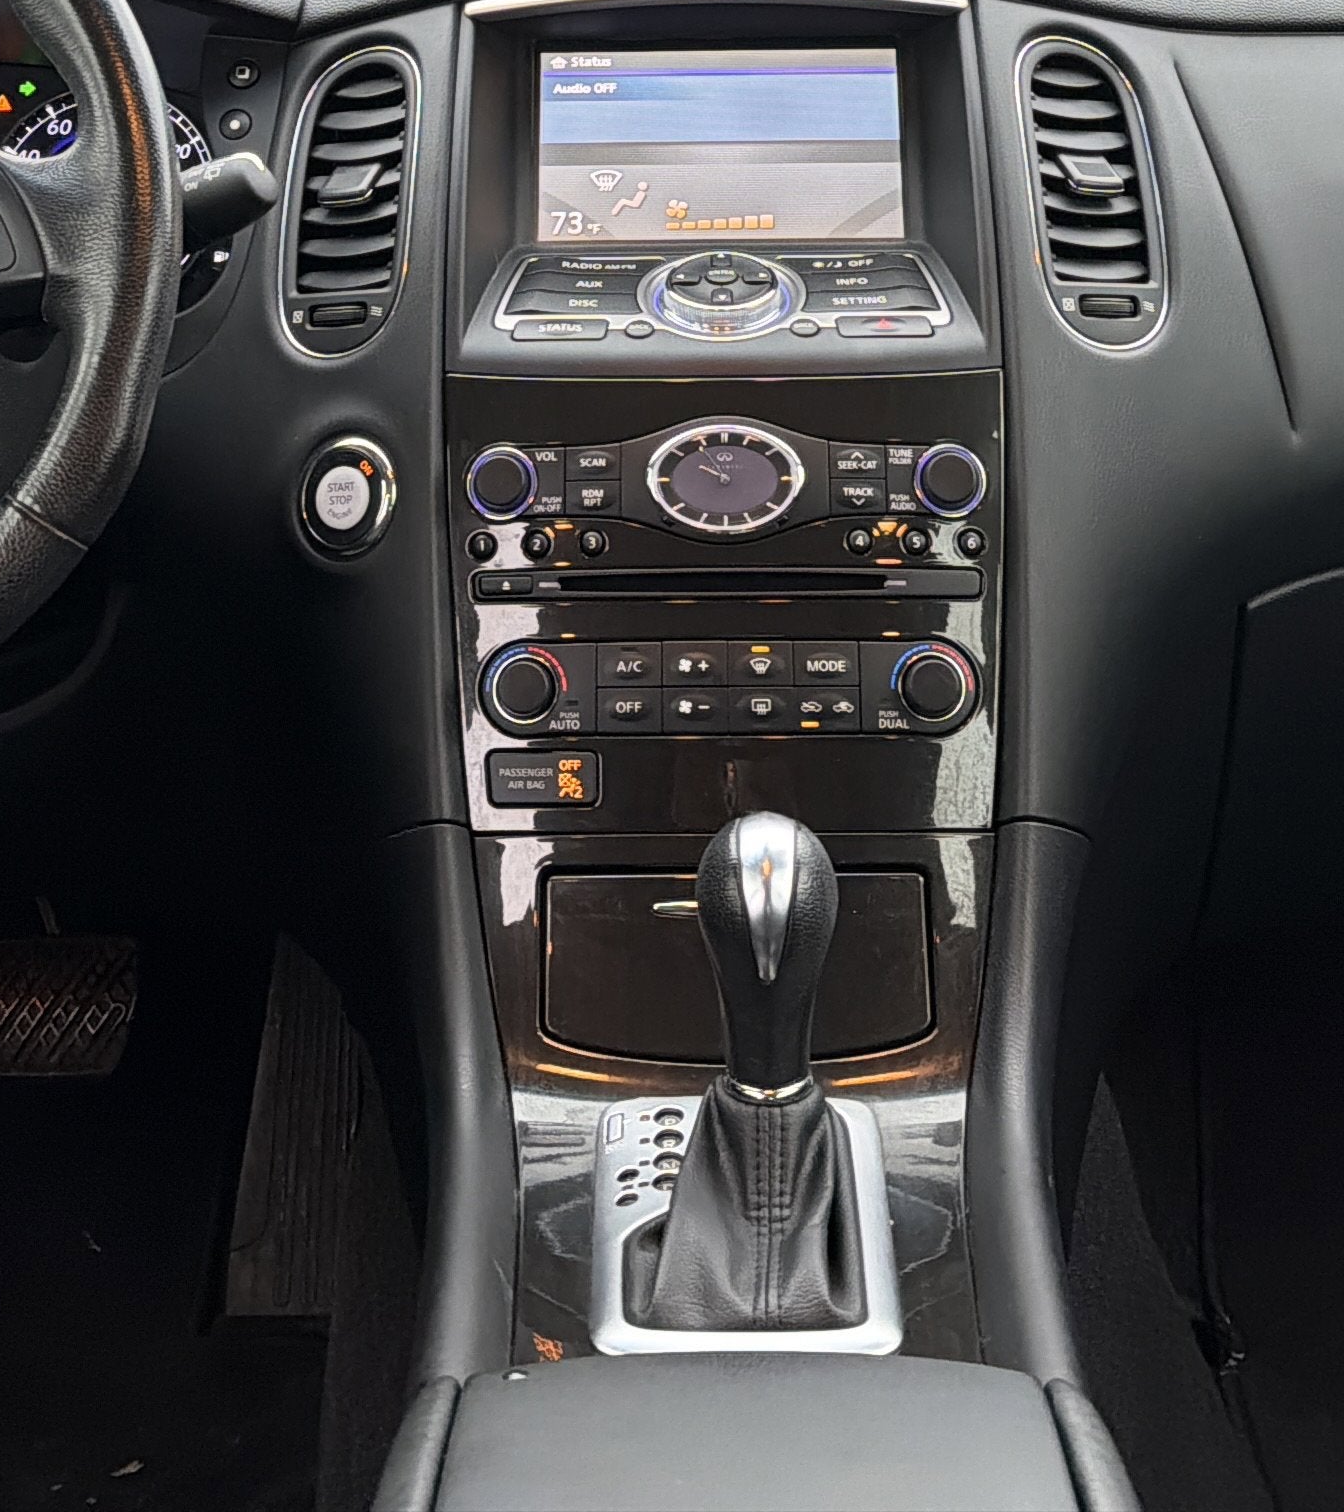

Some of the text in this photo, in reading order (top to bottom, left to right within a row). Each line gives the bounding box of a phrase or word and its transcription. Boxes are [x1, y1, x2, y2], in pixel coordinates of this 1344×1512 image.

[570, 56, 612, 68] Status
[553, 82, 618, 95] Audio OFF
[46, 119, 73, 136] 60
[183, 181, 199, 193] ON
[550, 211, 583, 236] 73
[562, 261, 603, 271] RADIO
[848, 258, 874, 268] OFF
[575, 280, 603, 289] AUX
[836, 276, 869, 286] INFO
[568, 298, 599, 308] DISC
[831, 295, 887, 306] SETTING
[538, 323, 583, 333] STATUS
[535, 451, 558, 462] VOL
[888, 448, 914, 458] TUNE
[359, 459, 376, 477] ON
[579, 458, 607, 468] SCAN
[327, 481, 356, 493] START
[842, 487, 875, 497] TRACK
[581, 489, 604, 498] RDM
[889, 494, 910, 502] PUSH
[329, 495, 353, 506] STOP
[541, 496, 563, 504] PUSH
[583, 498, 602, 507] RPT
[890, 501, 917, 511] AUDIO
[479, 540, 485, 552] 1
[532, 539, 541, 551] 2
[588, 537, 597, 549] 3
[855, 536, 864, 547] 4
[912, 537, 921, 548] 5
[967, 537, 976, 549] 6
[616, 660, 644, 673] A/C
[806, 660, 847, 673] MODE
[615, 701, 643, 714] OFF
[559, 711, 580, 719] PUSH
[878, 710, 899, 718] PUSH
[549, 719, 581, 731] AUTO
[878, 718, 911, 729] DUAL
[558, 759, 583, 771] OFF
[498, 767, 554, 777] PASSENGER
[507, 780, 546, 790] AIR BAG
